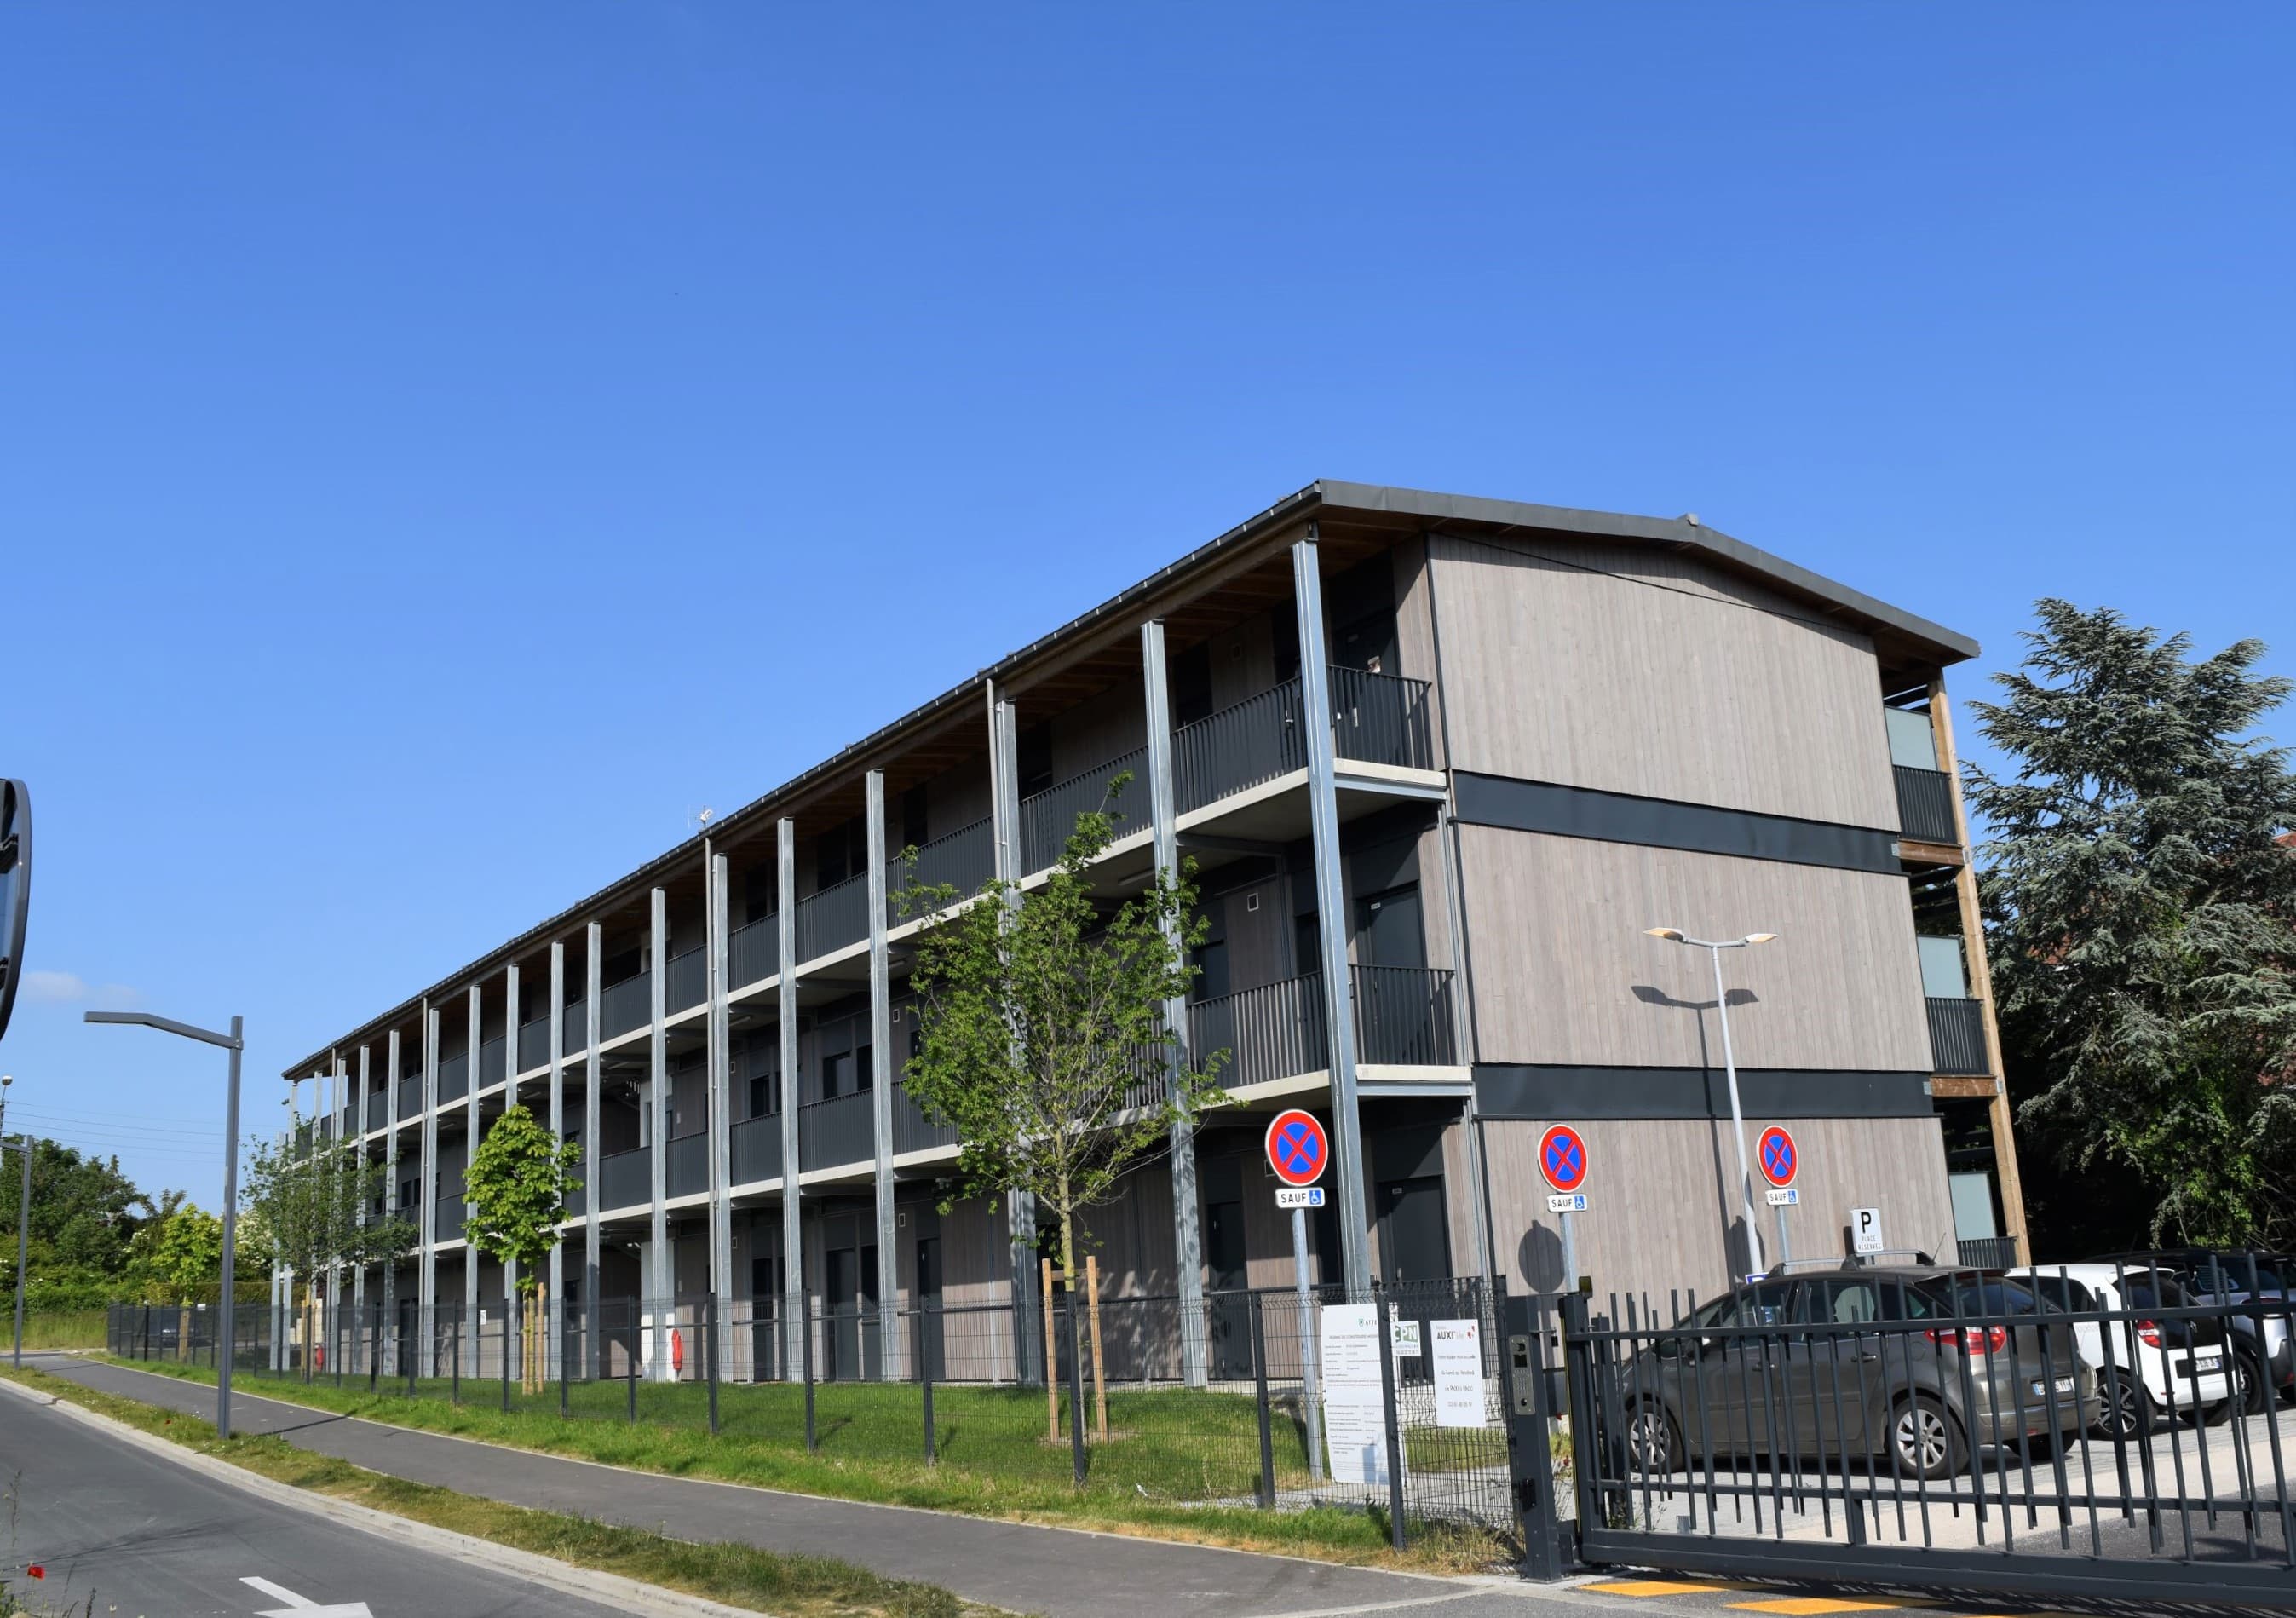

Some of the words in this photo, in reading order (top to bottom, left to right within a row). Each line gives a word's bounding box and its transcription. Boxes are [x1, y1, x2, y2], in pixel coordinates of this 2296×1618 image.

[1280, 1193, 1306, 1203] SAUF
[1769, 1193, 1787, 1201] SAUF
[1551, 1198, 1573, 1208] SAUF
[1861, 1212, 1872, 1234] P
